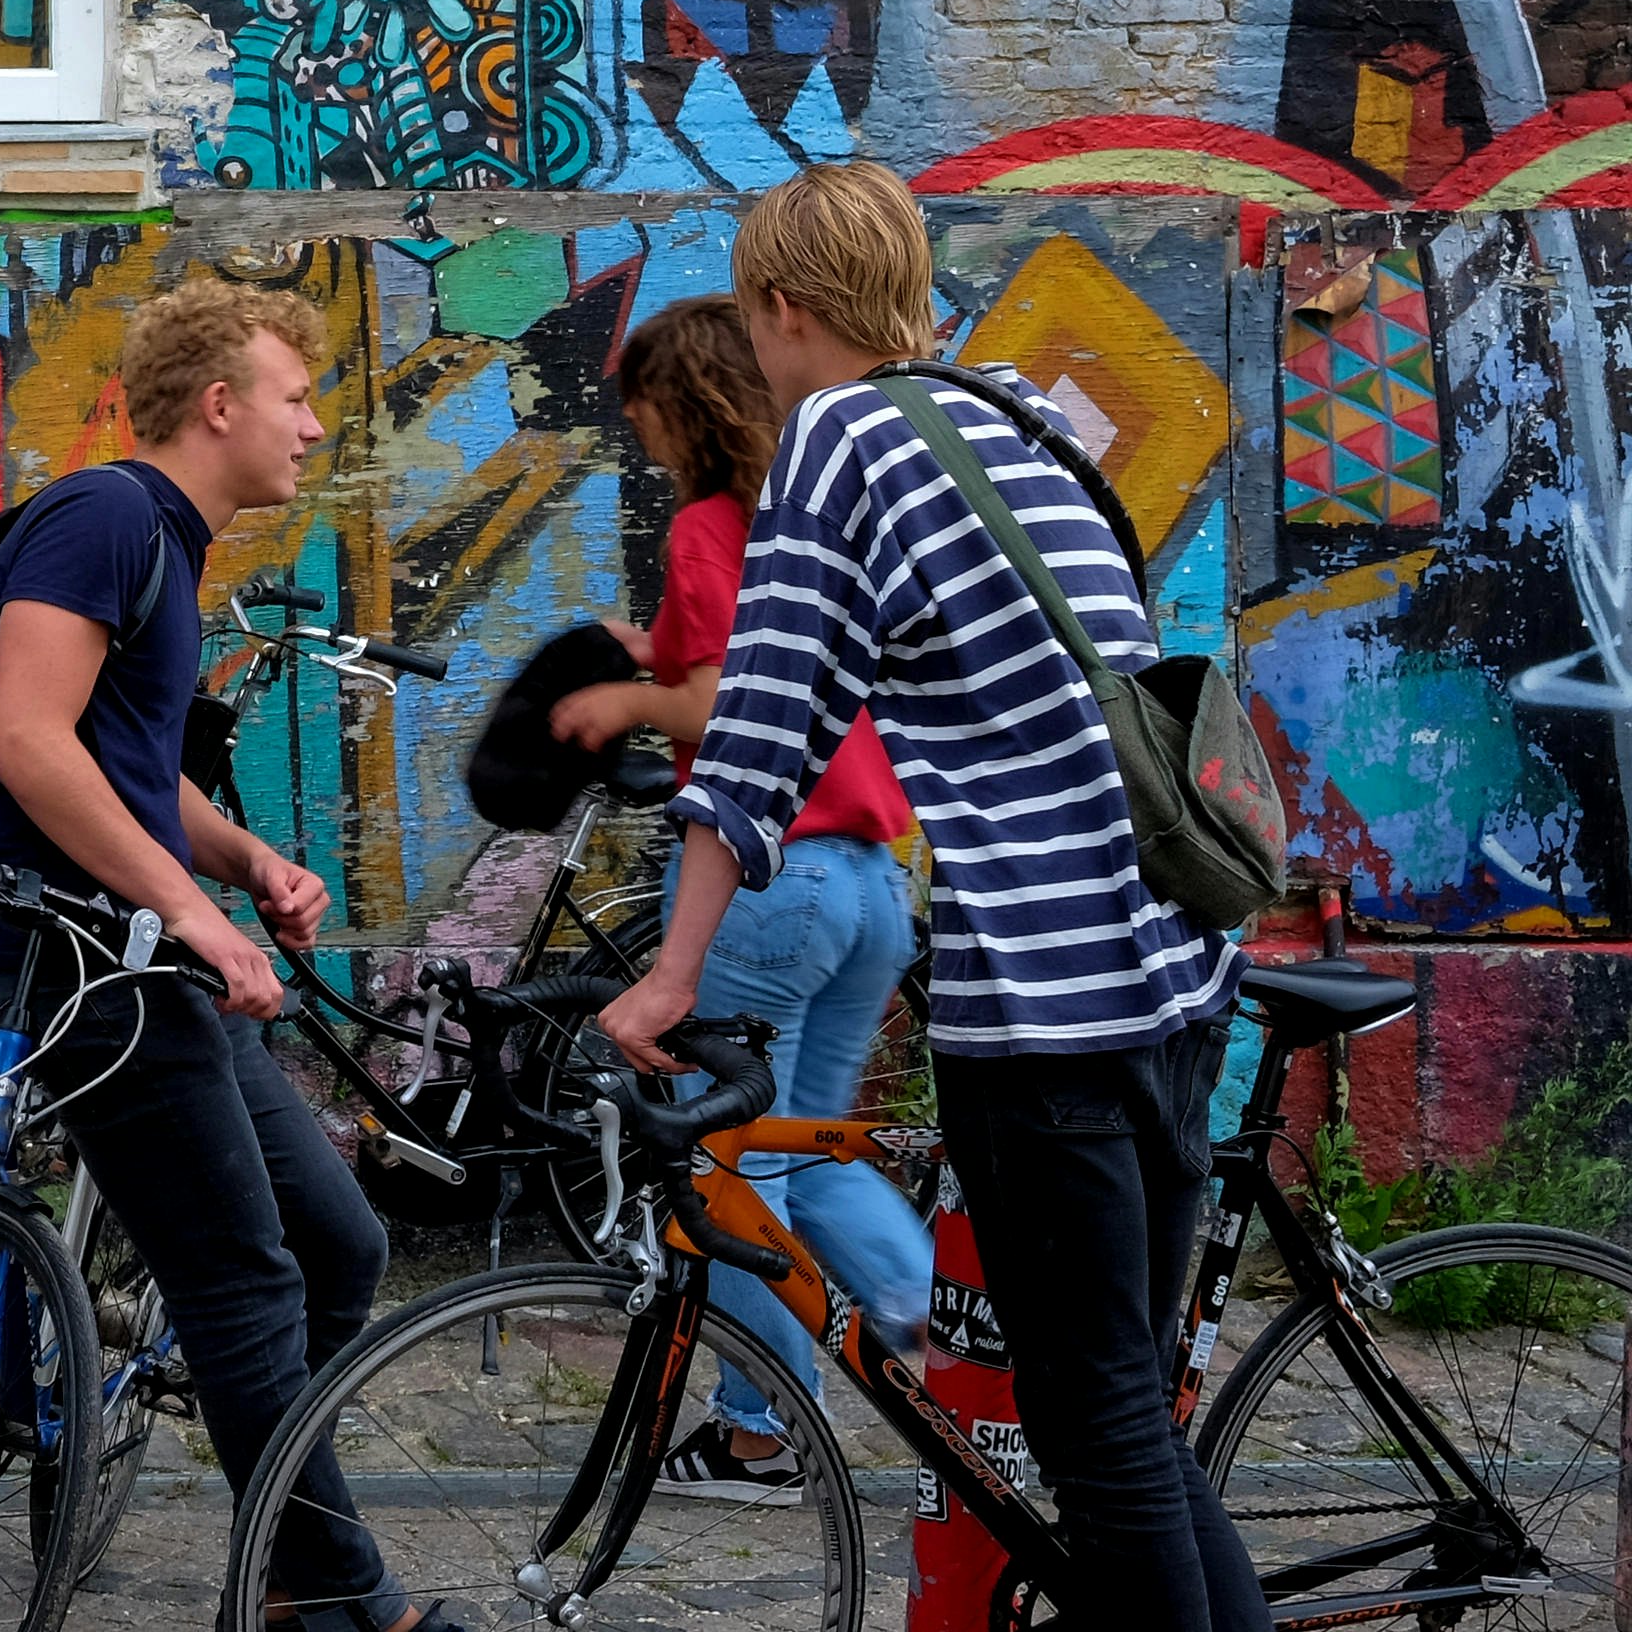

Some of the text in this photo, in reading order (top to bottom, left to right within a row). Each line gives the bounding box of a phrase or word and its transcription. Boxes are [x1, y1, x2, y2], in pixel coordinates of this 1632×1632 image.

[815, 1130, 845, 1144] 600
[1211, 1275, 1230, 1307] 600
[649, 1404, 668, 1457] carbon
[883, 1358, 1013, 1505] Crescent
